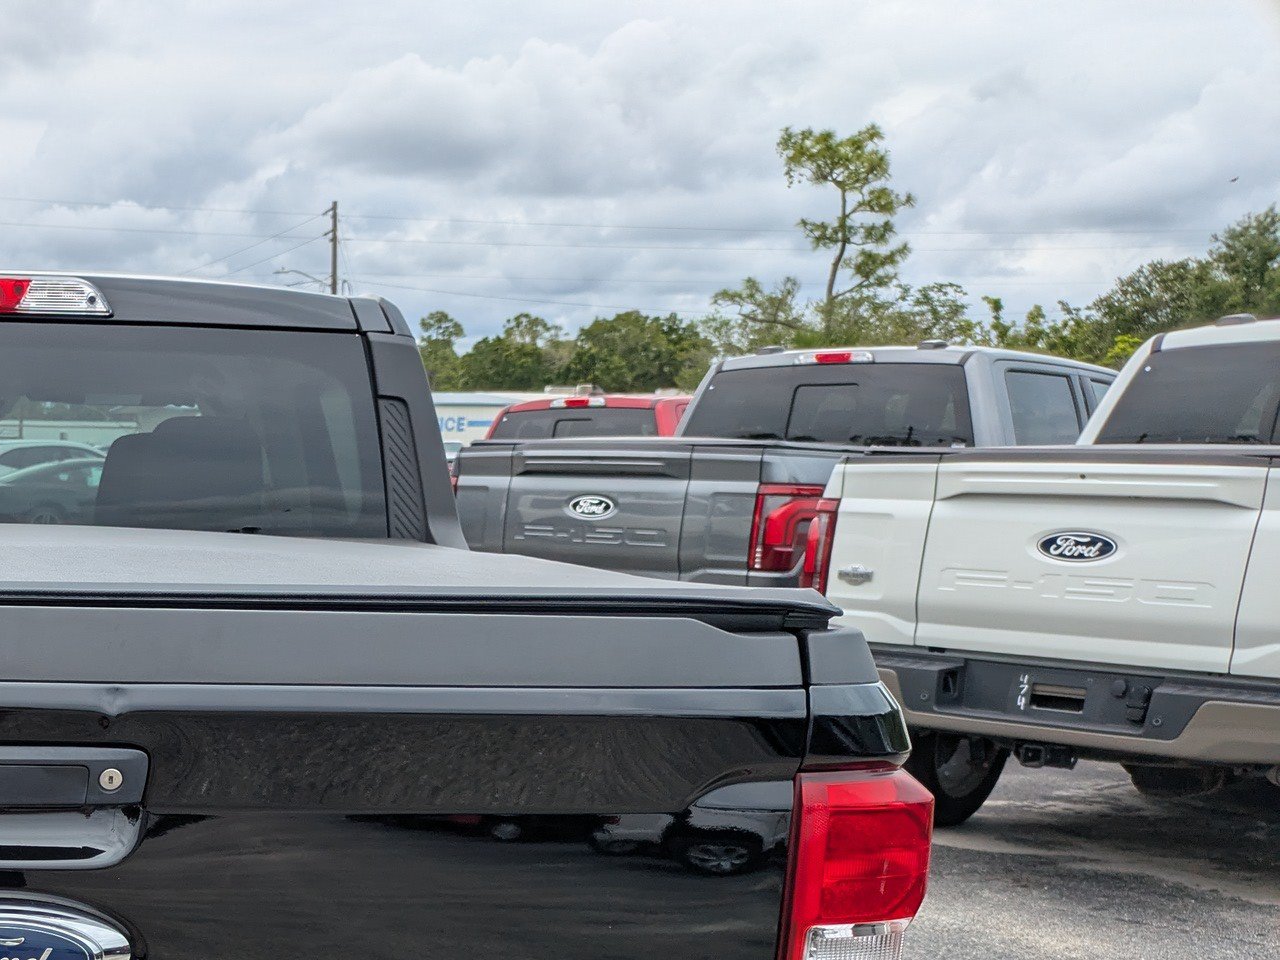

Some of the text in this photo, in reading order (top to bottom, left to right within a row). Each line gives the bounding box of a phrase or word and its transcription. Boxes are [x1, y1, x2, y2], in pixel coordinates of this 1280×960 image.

[575, 499, 607, 515] Ford
[514, 523, 668, 547] F-150
[1049, 534, 1102, 558] Ford
[937, 567, 1216, 608] F-150
